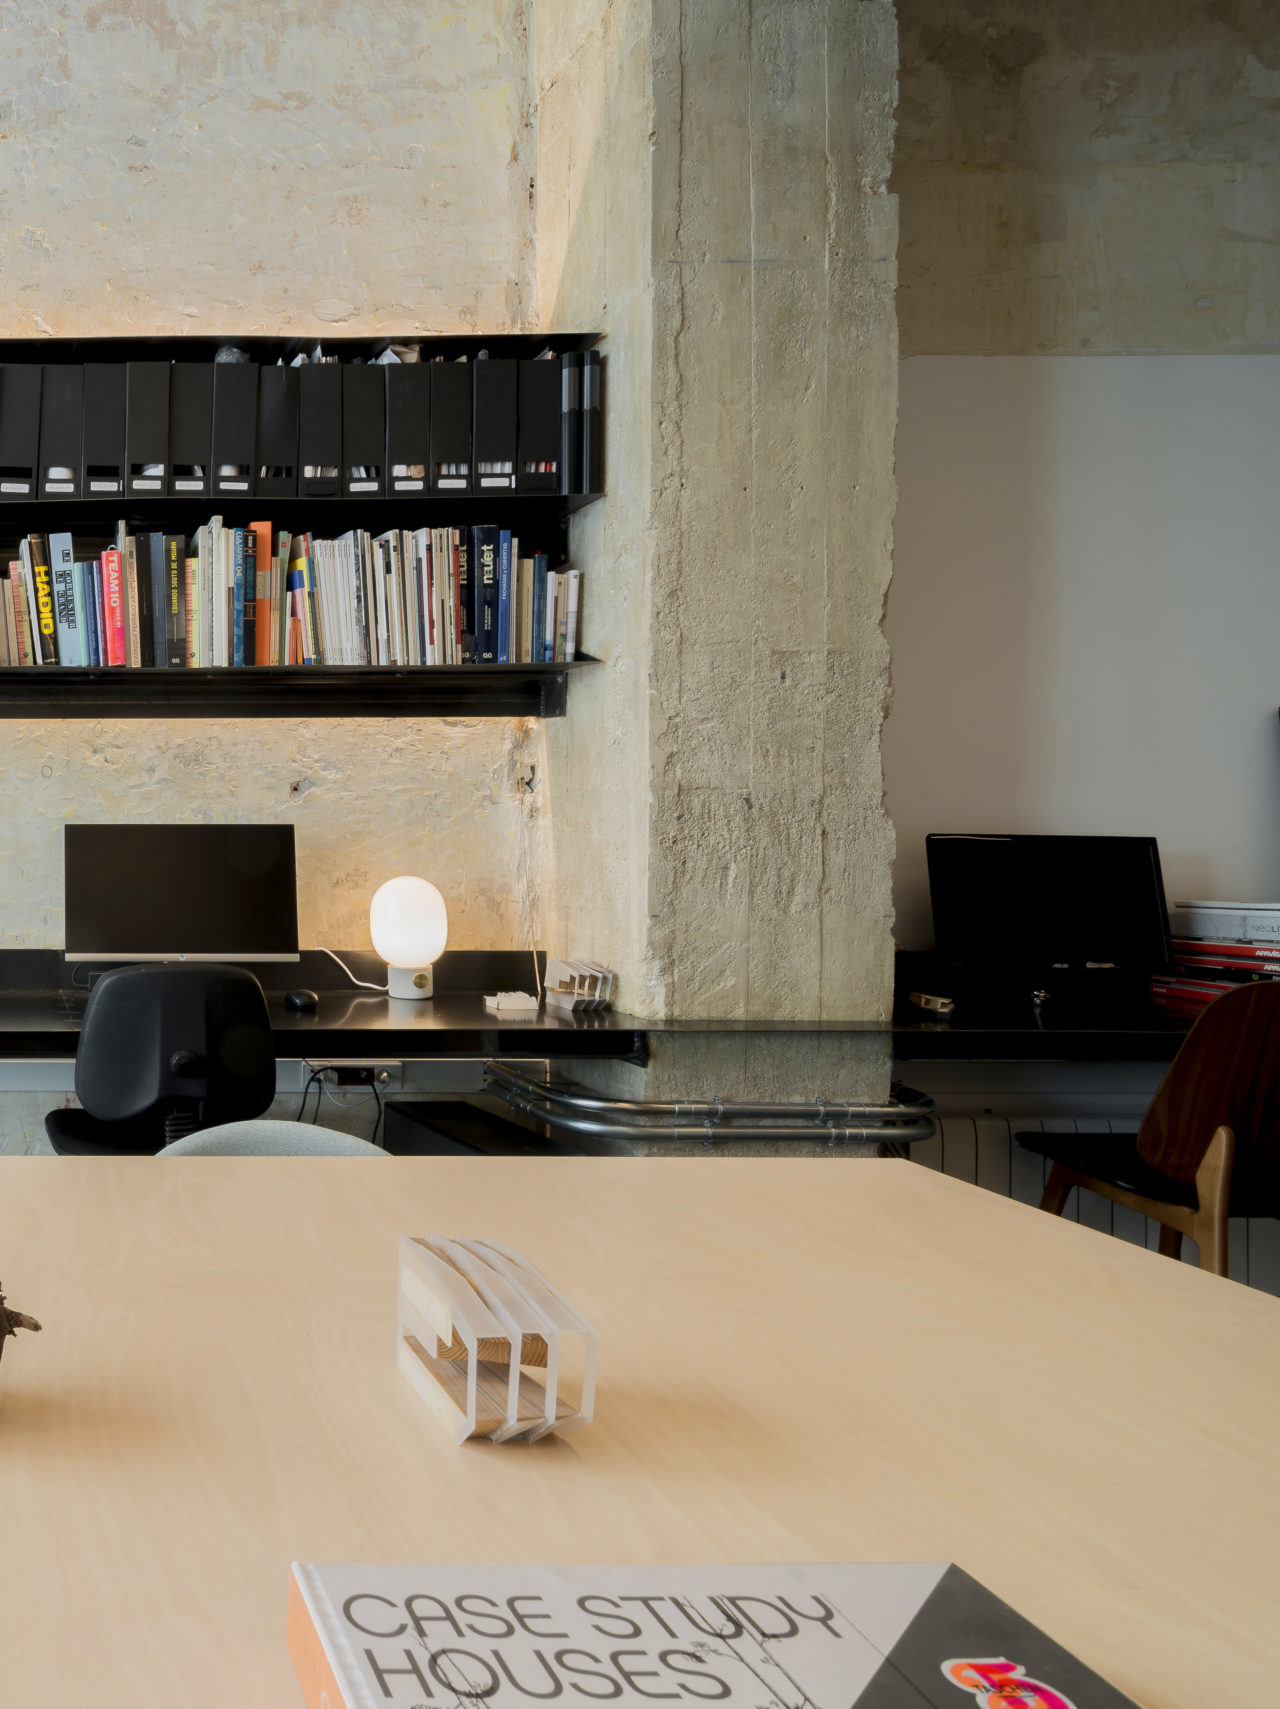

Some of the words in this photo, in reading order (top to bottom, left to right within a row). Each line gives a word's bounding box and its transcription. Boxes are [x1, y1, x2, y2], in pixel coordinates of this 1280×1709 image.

[62, 549, 71, 563] LE
[236, 566, 243, 576] 04
[481, 544, 494, 584] neufert
[56, 570, 65, 584] LE
[34, 565, 55, 635] HADID
[57, 590, 67, 624] GRAND
[64, 570, 77, 629] CORBUSIER
[342, 1593, 570, 1638] CASE
[576, 1594, 843, 1639] STUDY
[363, 1648, 732, 1700] HOUSES
